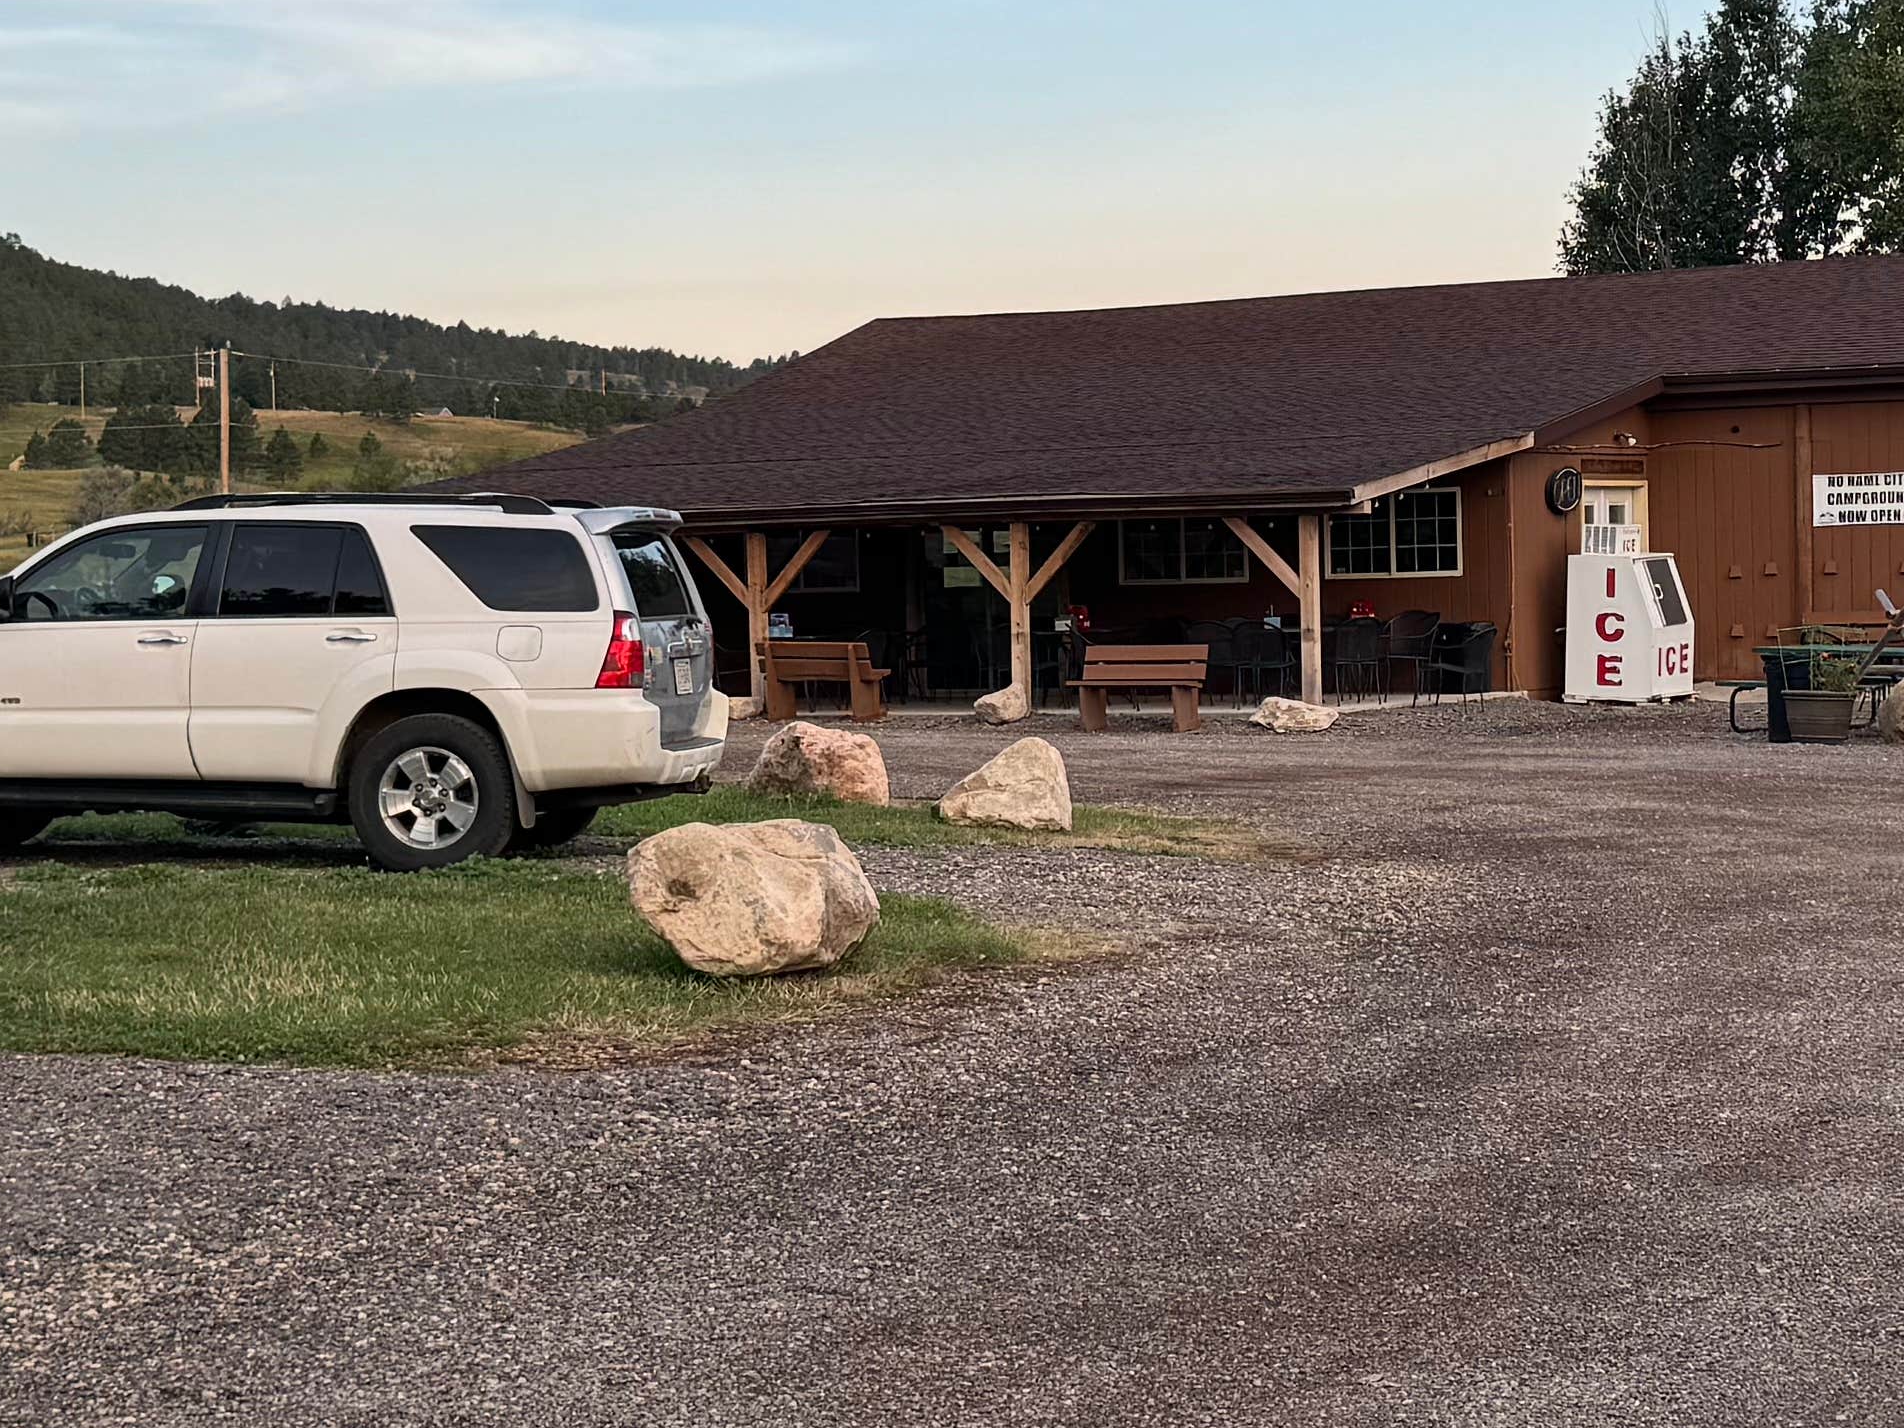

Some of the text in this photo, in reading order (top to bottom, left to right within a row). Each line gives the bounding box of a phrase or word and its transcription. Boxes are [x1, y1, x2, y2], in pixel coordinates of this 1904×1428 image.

[1828, 476, 1844, 487] NO
[1847, 474, 1880, 486] NAME
[1838, 509, 1901, 523] NOW OPEN
[1623, 539, 1636, 552] ICE
[1595, 567, 1625, 686] ICE
[1657, 642, 1689, 677] ICE
